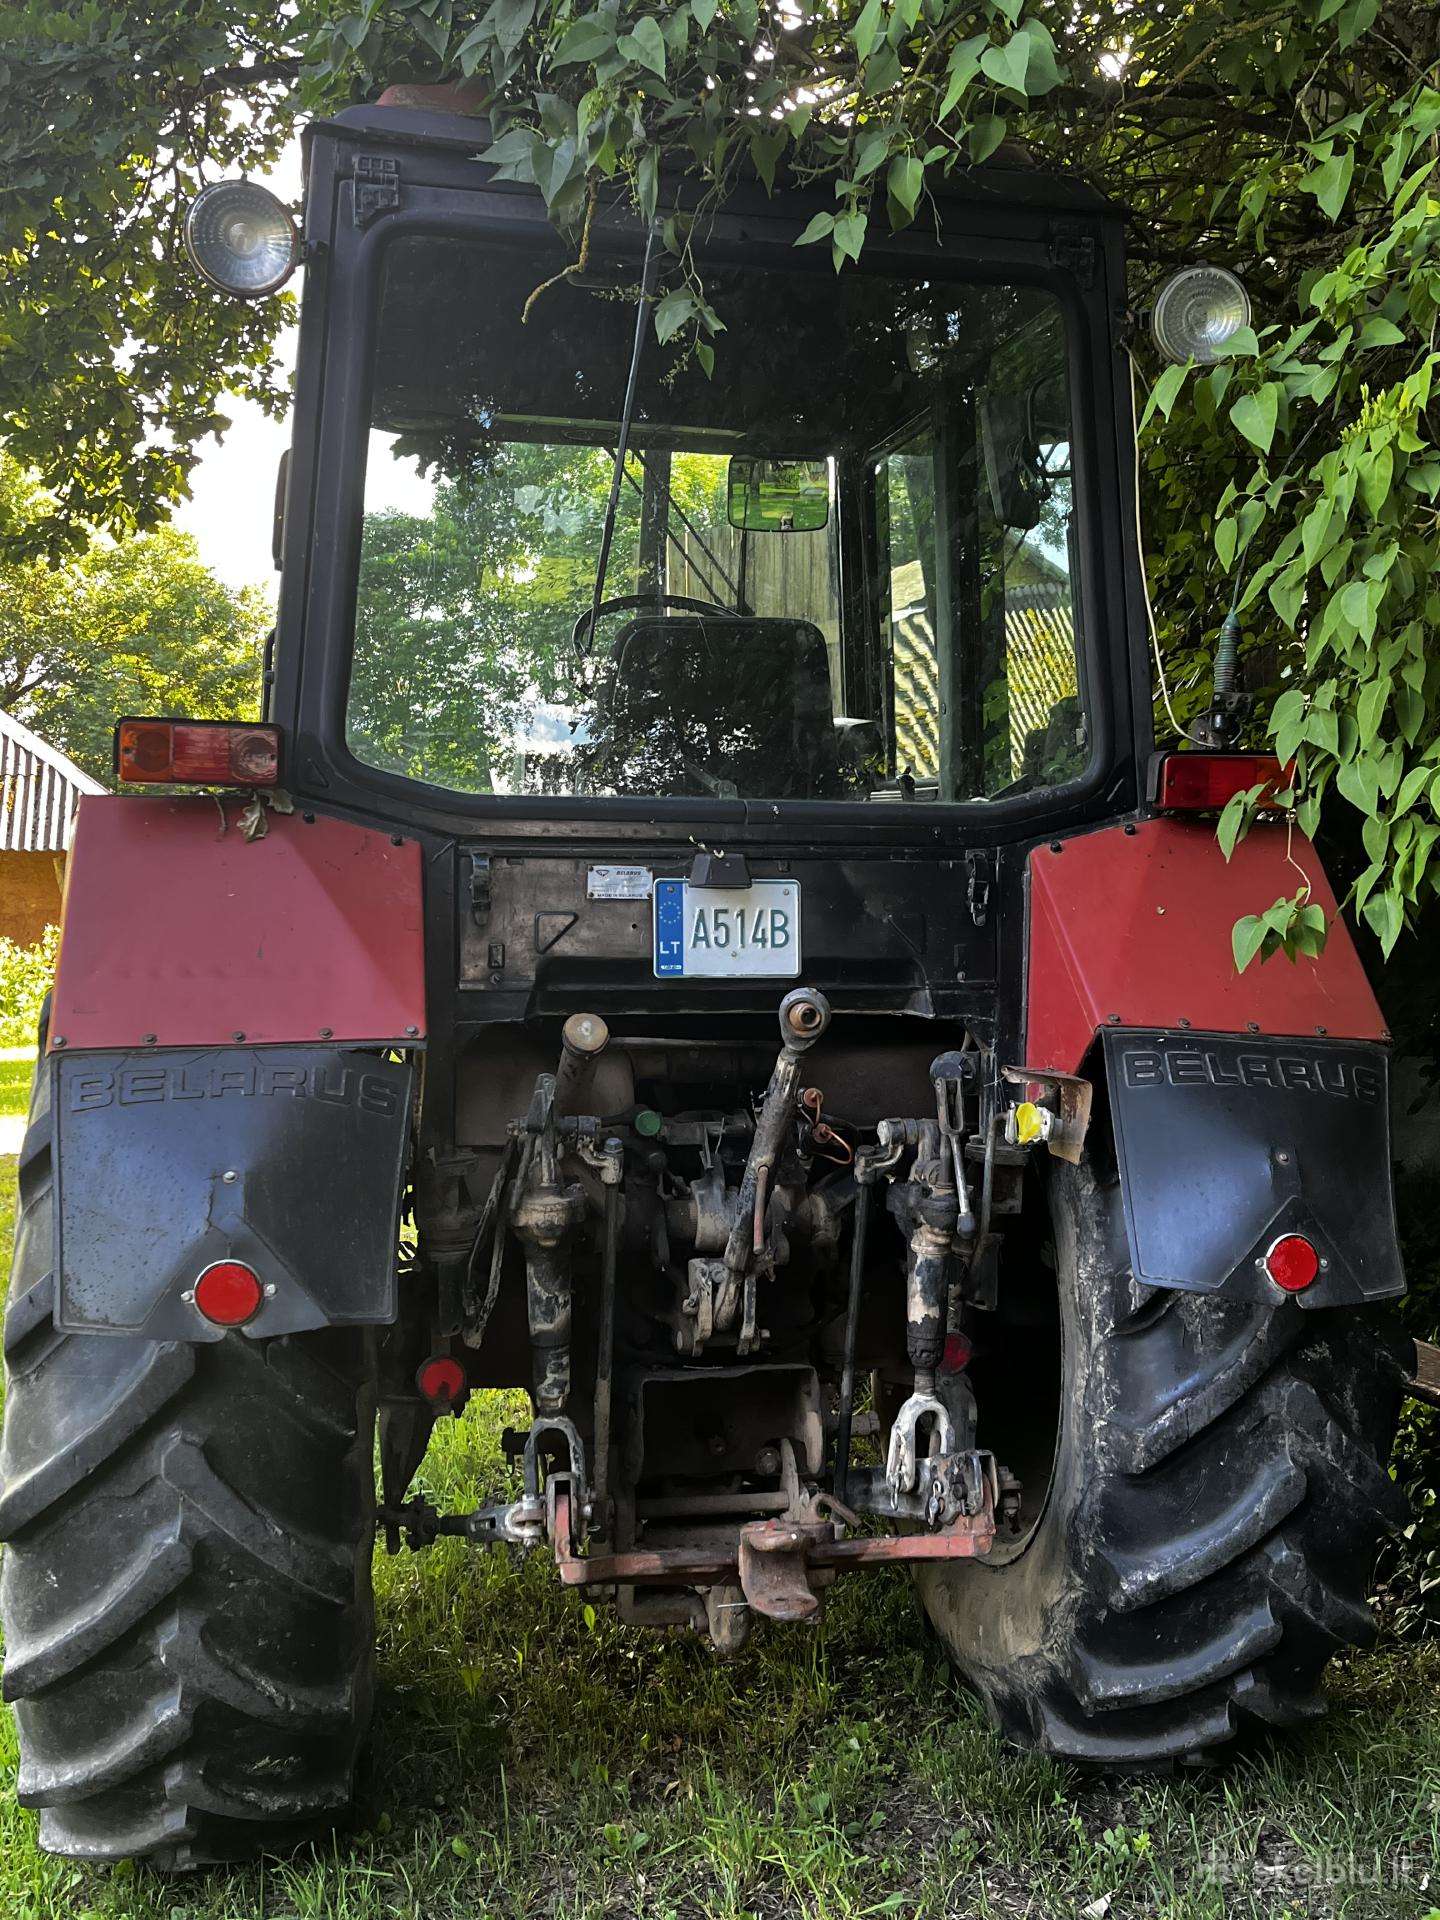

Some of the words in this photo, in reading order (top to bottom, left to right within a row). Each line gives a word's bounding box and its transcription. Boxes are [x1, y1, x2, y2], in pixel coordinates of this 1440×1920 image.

[660, 941, 681, 955] LT
[691, 908, 790, 949] A514B
[70, 1065, 402, 1118] BELARUS
[1122, 1051, 1384, 1105] BELARUS
